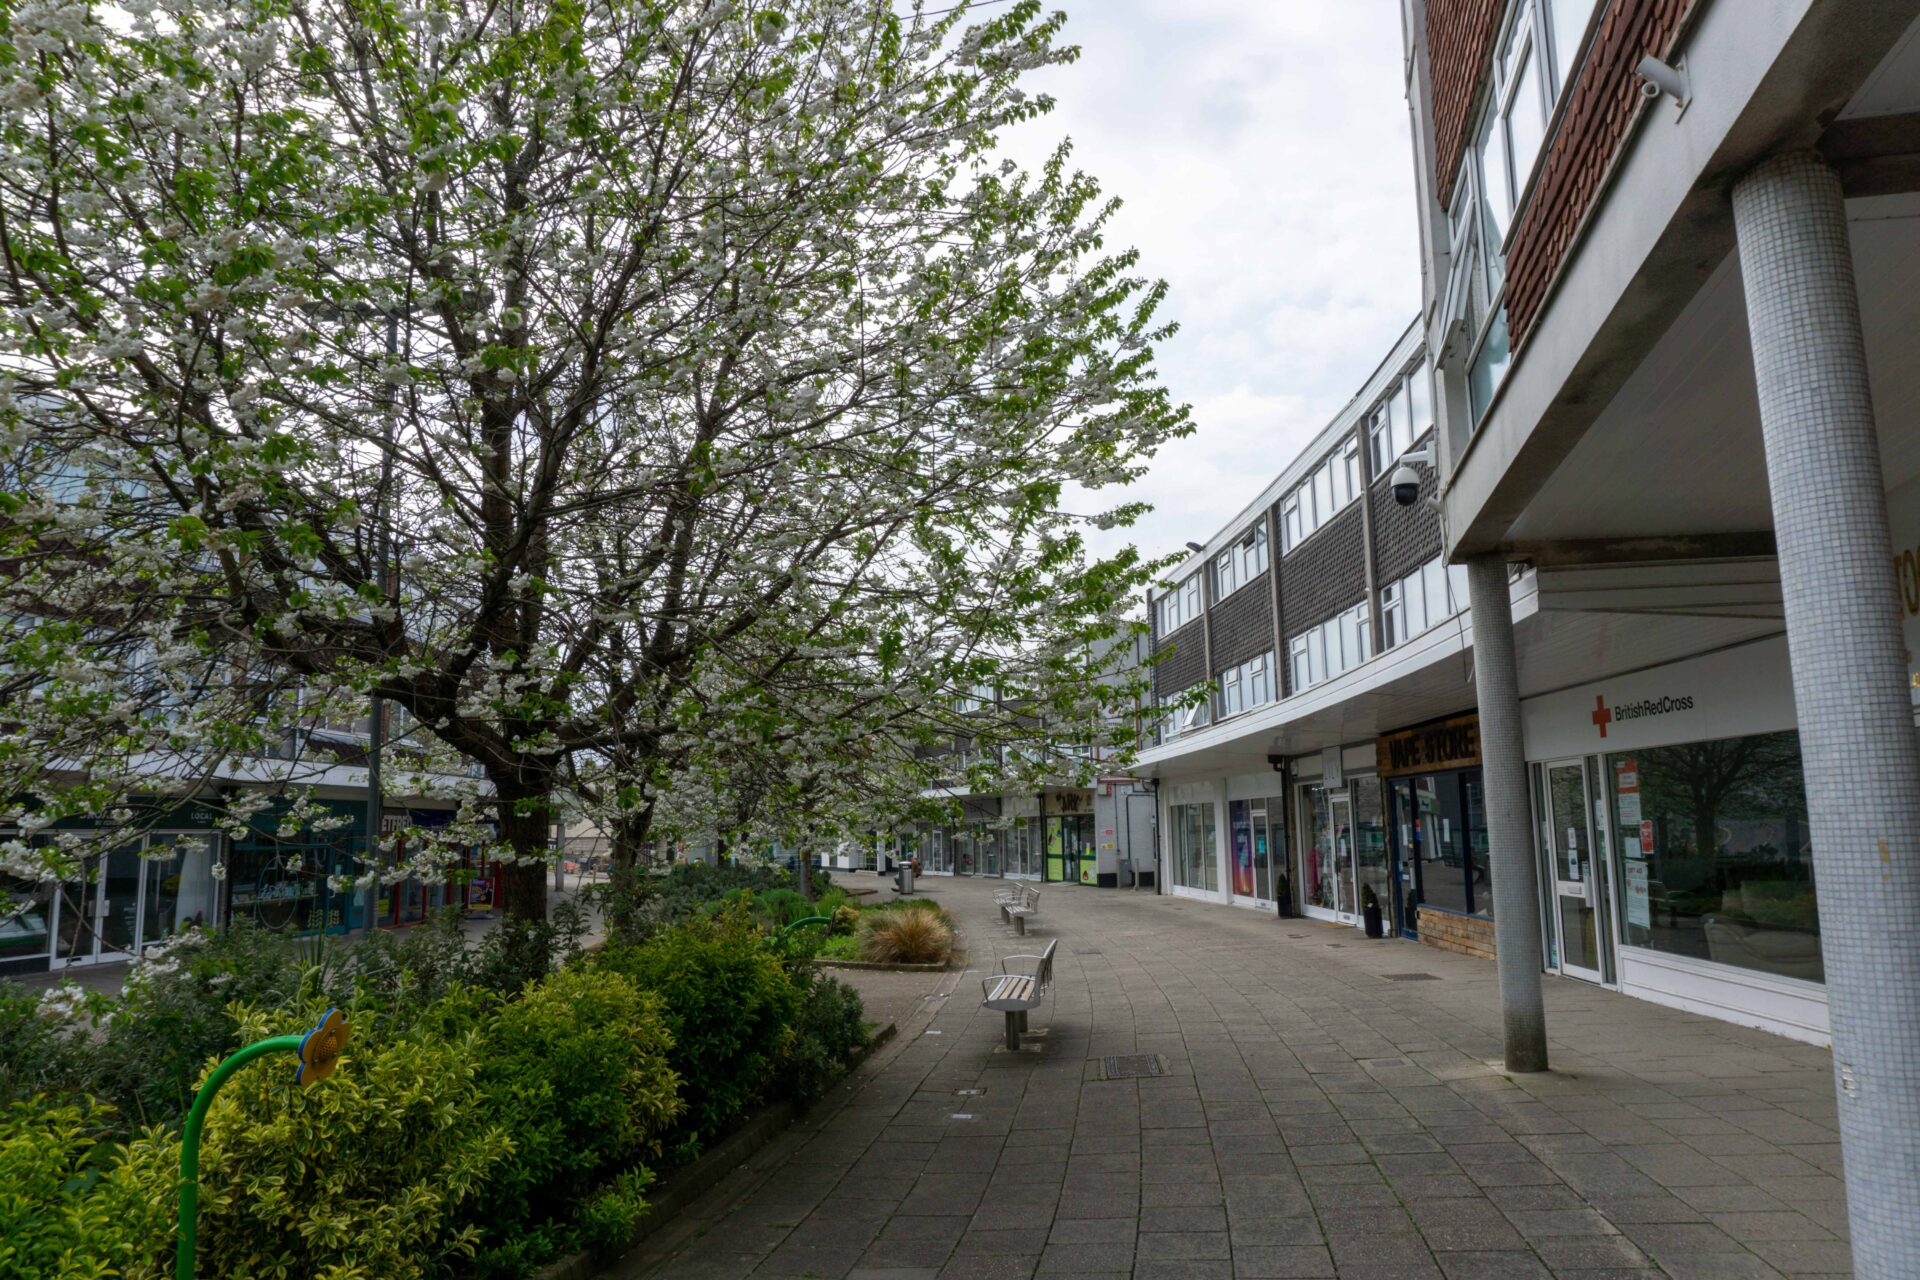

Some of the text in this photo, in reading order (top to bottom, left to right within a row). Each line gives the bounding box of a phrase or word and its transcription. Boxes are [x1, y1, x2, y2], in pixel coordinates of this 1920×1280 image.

[1615, 696, 1694, 721] BritishRedCross
[1389, 724, 1475, 770] VAPE STORE
[381, 815, 413, 832] ETFRED
